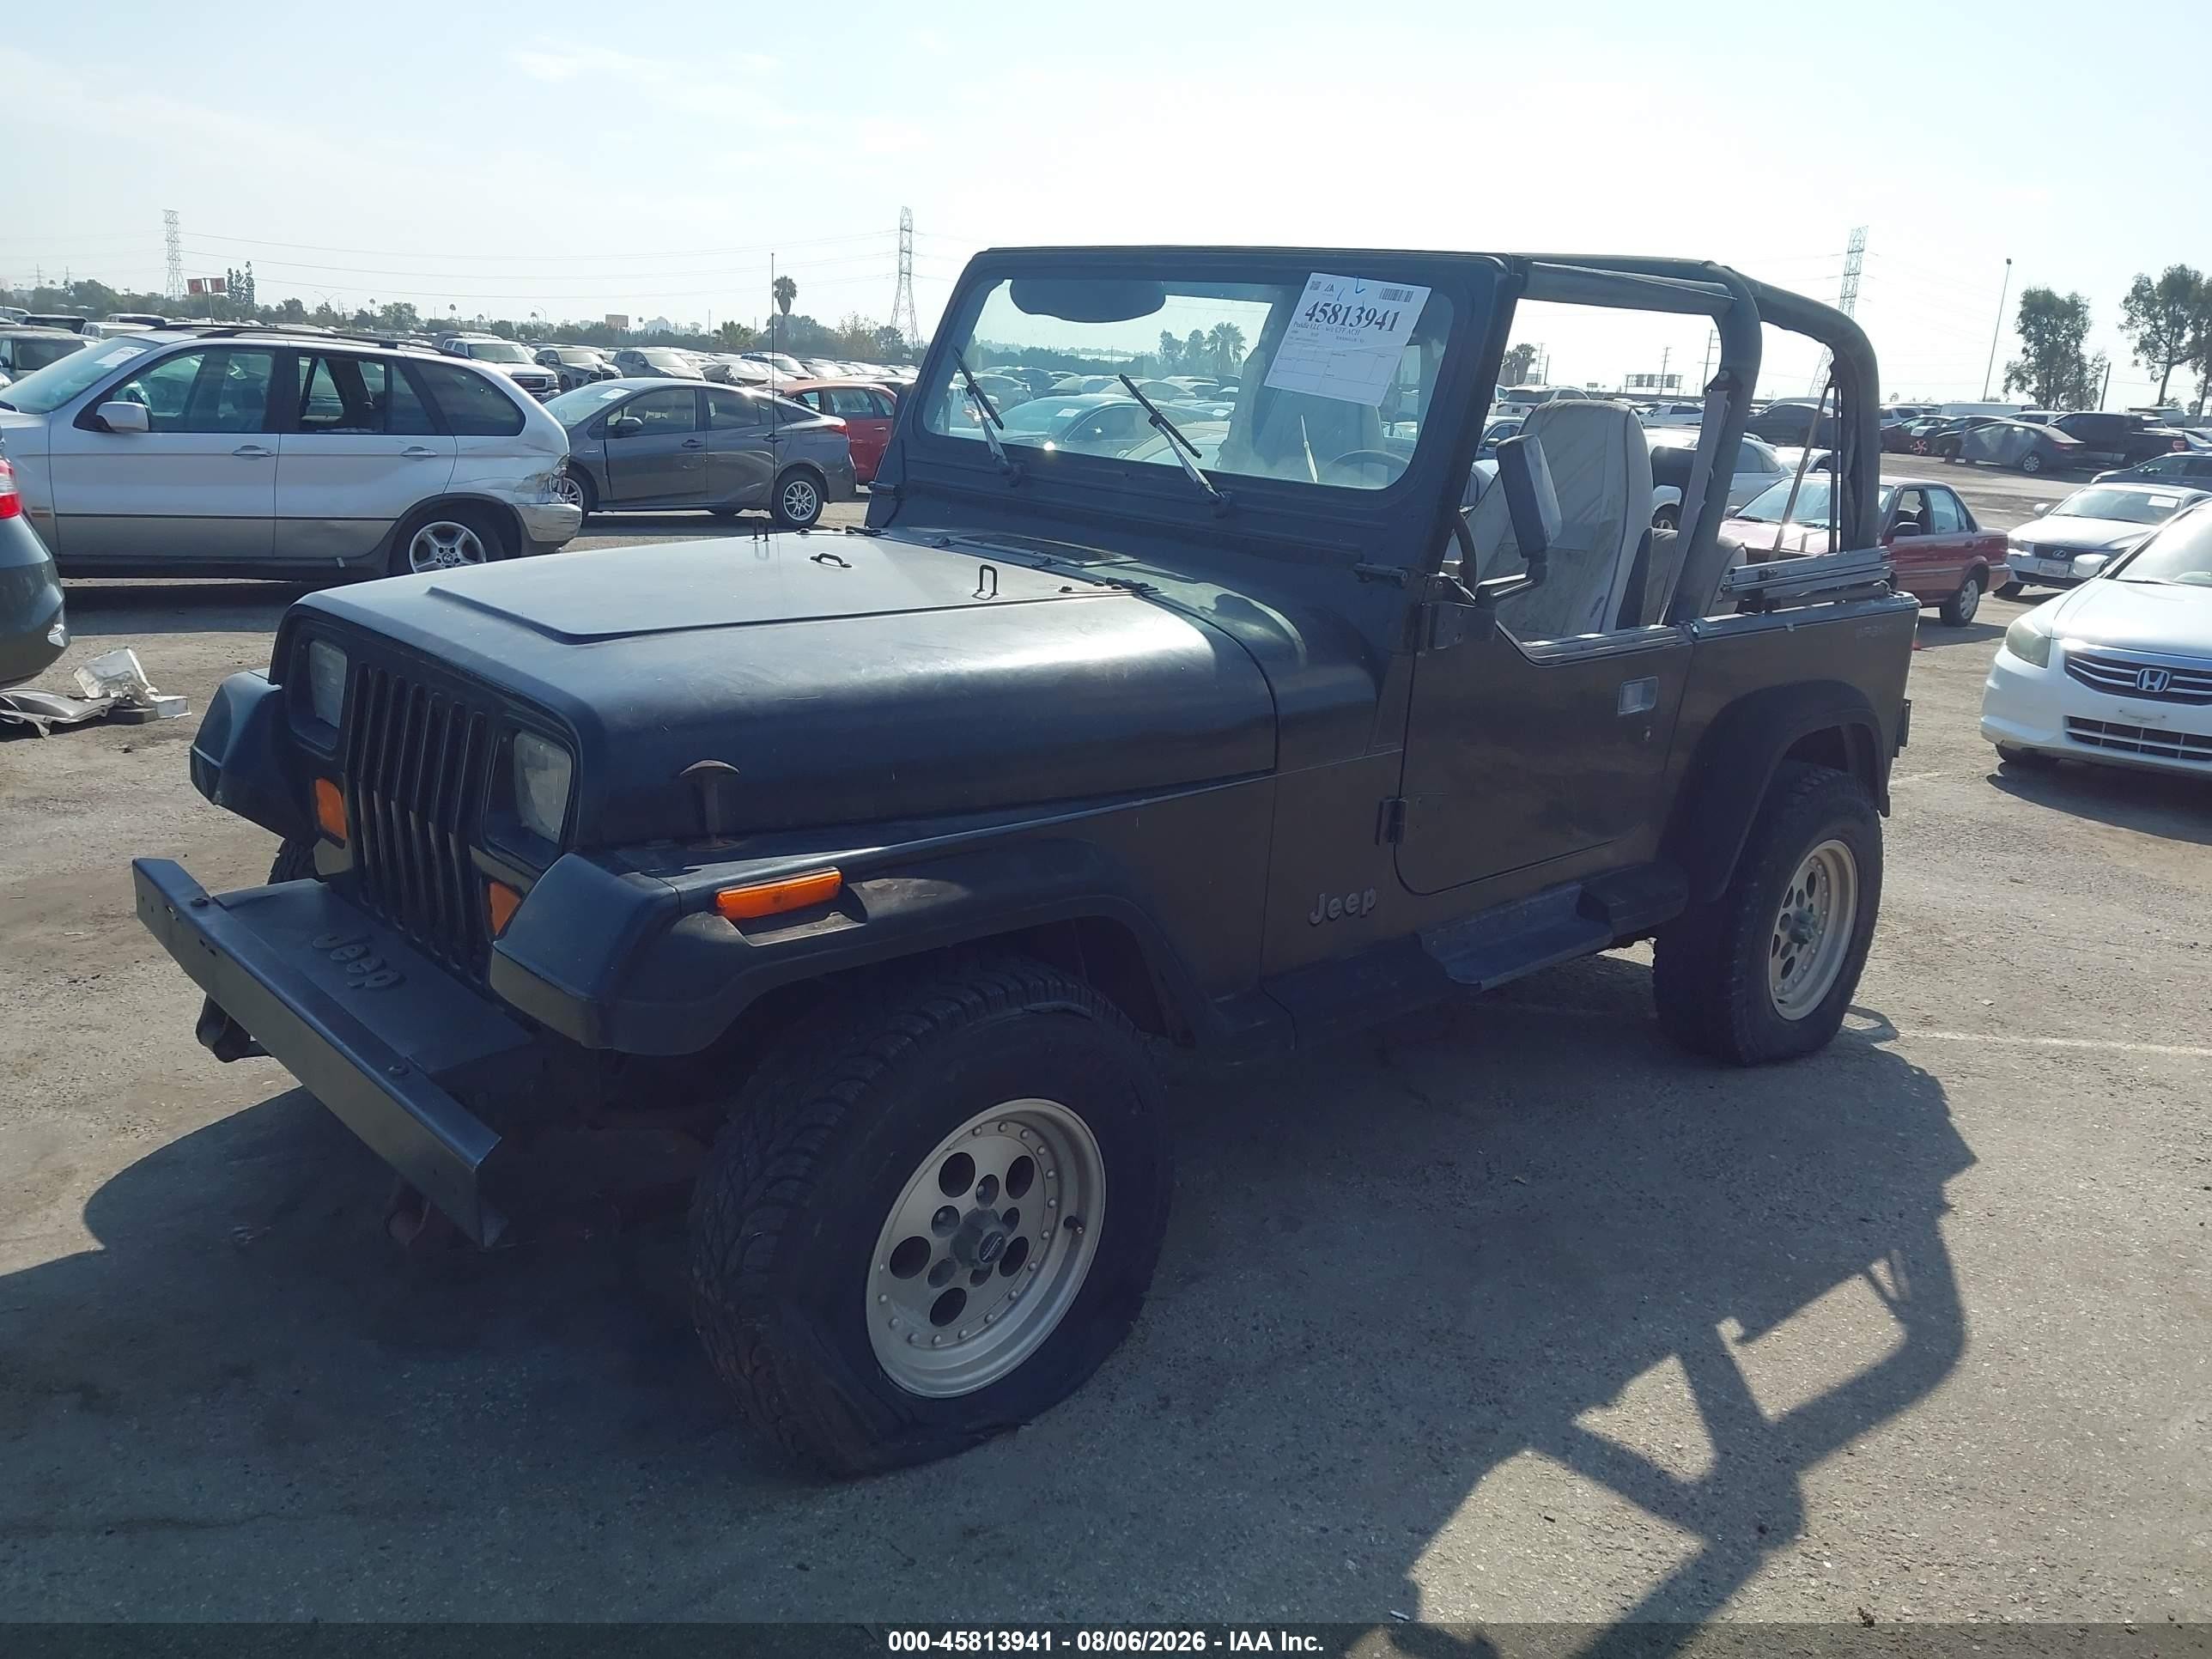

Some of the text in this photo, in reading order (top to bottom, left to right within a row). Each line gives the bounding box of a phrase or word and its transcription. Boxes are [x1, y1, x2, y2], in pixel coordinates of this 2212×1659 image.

[1304, 301, 1401, 331] 45813941
[1308, 888, 1376, 926] Jeep
[312, 933, 404, 989] Jeep
